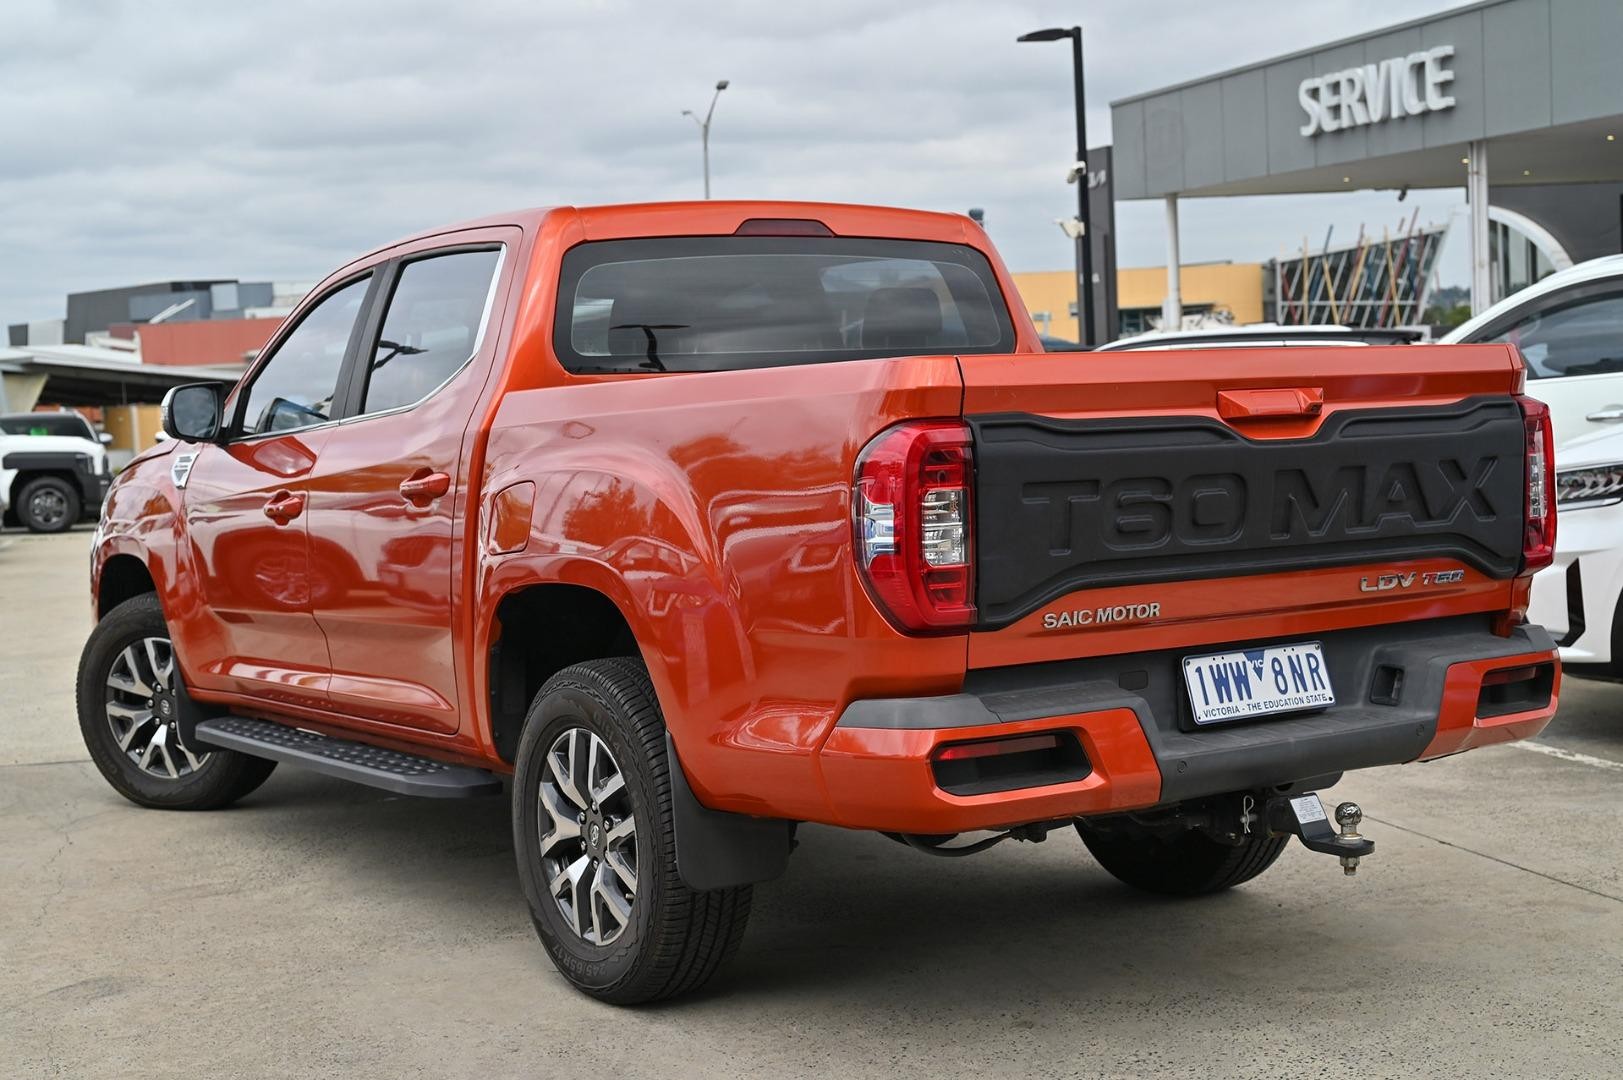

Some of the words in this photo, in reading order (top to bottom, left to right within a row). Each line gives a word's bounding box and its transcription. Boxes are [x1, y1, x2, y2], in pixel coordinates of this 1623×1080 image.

[1298, 45, 1456, 137] SERVICE
[1021, 473, 1248, 557] T60
[1270, 456, 1498, 540] MAX
[1360, 571, 1417, 592] LDV
[1422, 569, 1464, 585] T60
[1043, 609, 1092, 629] SAIC
[1095, 602, 1161, 624] MOTOR
[1195, 660, 1253, 706] 1WW
[1271, 653, 1326, 695] 8NR
[1202, 706, 1241, 719] VICTORIA
[1247, 701, 1263, 712] THE
[1264, 696, 1305, 709] EDUCATION
[1305, 693, 1327, 704] STATE
